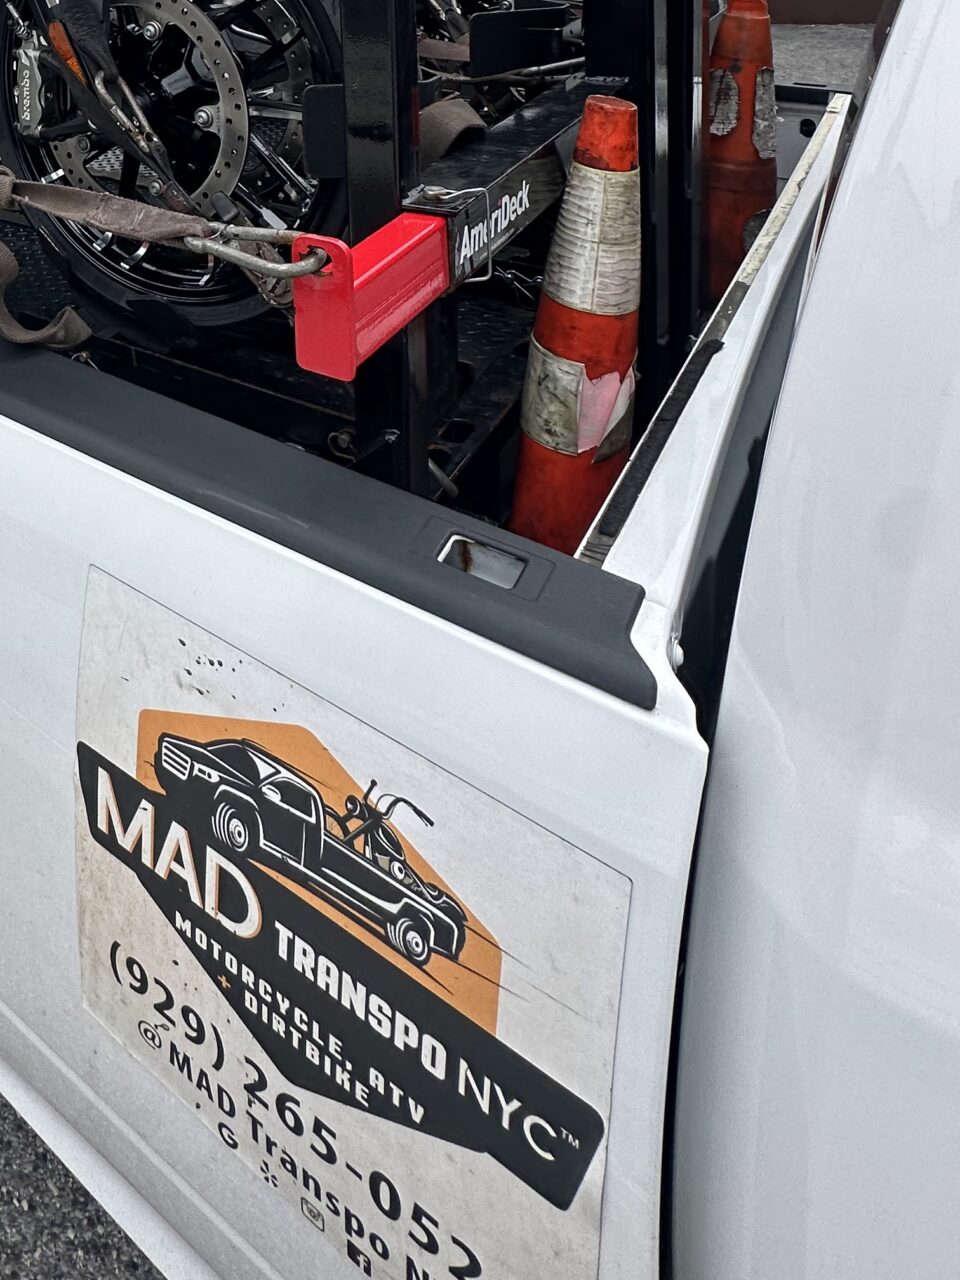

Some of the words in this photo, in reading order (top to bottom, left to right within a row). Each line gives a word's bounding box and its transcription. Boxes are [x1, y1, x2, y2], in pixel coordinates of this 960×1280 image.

[22, 69, 31, 121] brembo
[97, 766, 263, 939] MAD
[275, 920, 447, 1081] TRANSPO
[110, 940, 225, 1071] (929)
[175, 910, 353, 1071] MOTORCYCLE,
[369, 1066, 425, 1125] ATV
[244, 989, 370, 1108] DIRTBIKE
[245, 1109, 390, 1261] Transpo
